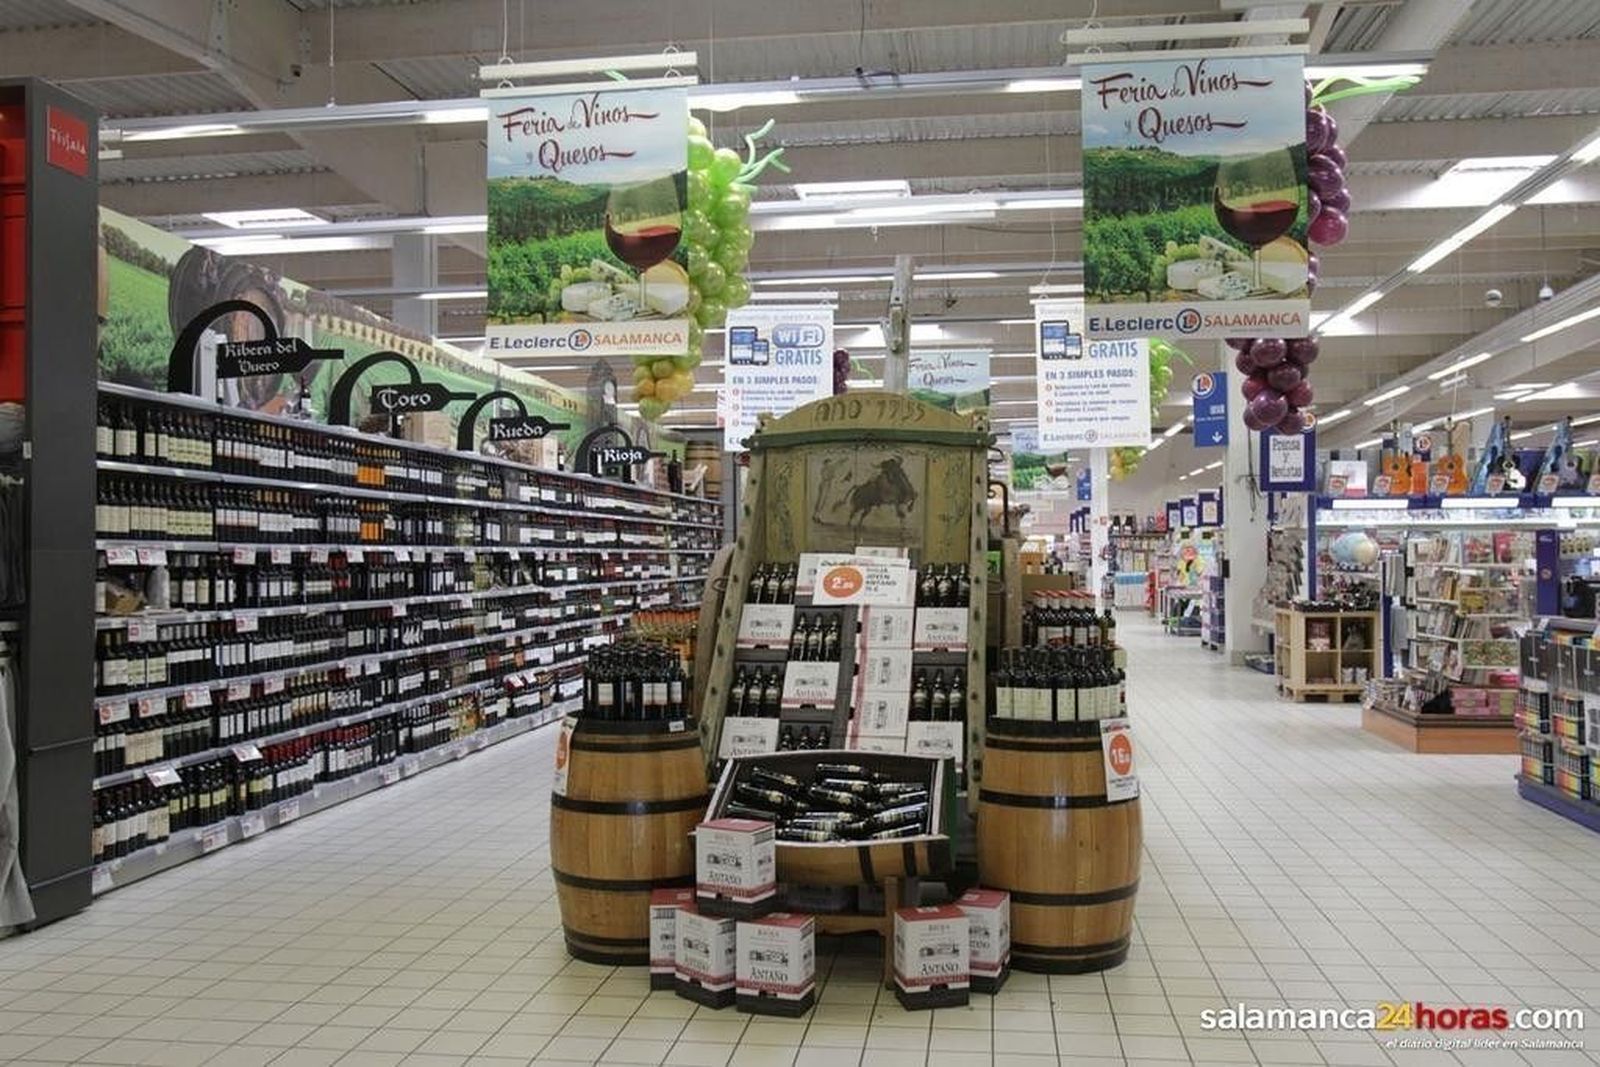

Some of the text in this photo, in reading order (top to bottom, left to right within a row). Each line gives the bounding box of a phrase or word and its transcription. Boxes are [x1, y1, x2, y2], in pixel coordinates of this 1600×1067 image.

[1090, 58, 1273, 110] Feria de Vinos
[496, 92, 660, 142] Feria de Vinos
[1124, 107, 1247, 142] y Quesos
[538, 139, 636, 173] Quesos
[1089, 316, 1173, 332] E.Leclerc
[1204, 312, 1300, 327] SALAMANCA
[224, 338, 298, 358] Ribera del
[490, 335, 567, 349] E.Leclerc
[594, 332, 682, 346] SALAMANCA
[1088, 342, 1138, 358] GRATIS
[775, 350, 823, 366] GRATIS
[377, 387, 431, 409] Toro
[492, 422, 544, 439] Rueda
[604, 448, 643, 465] Rioja
